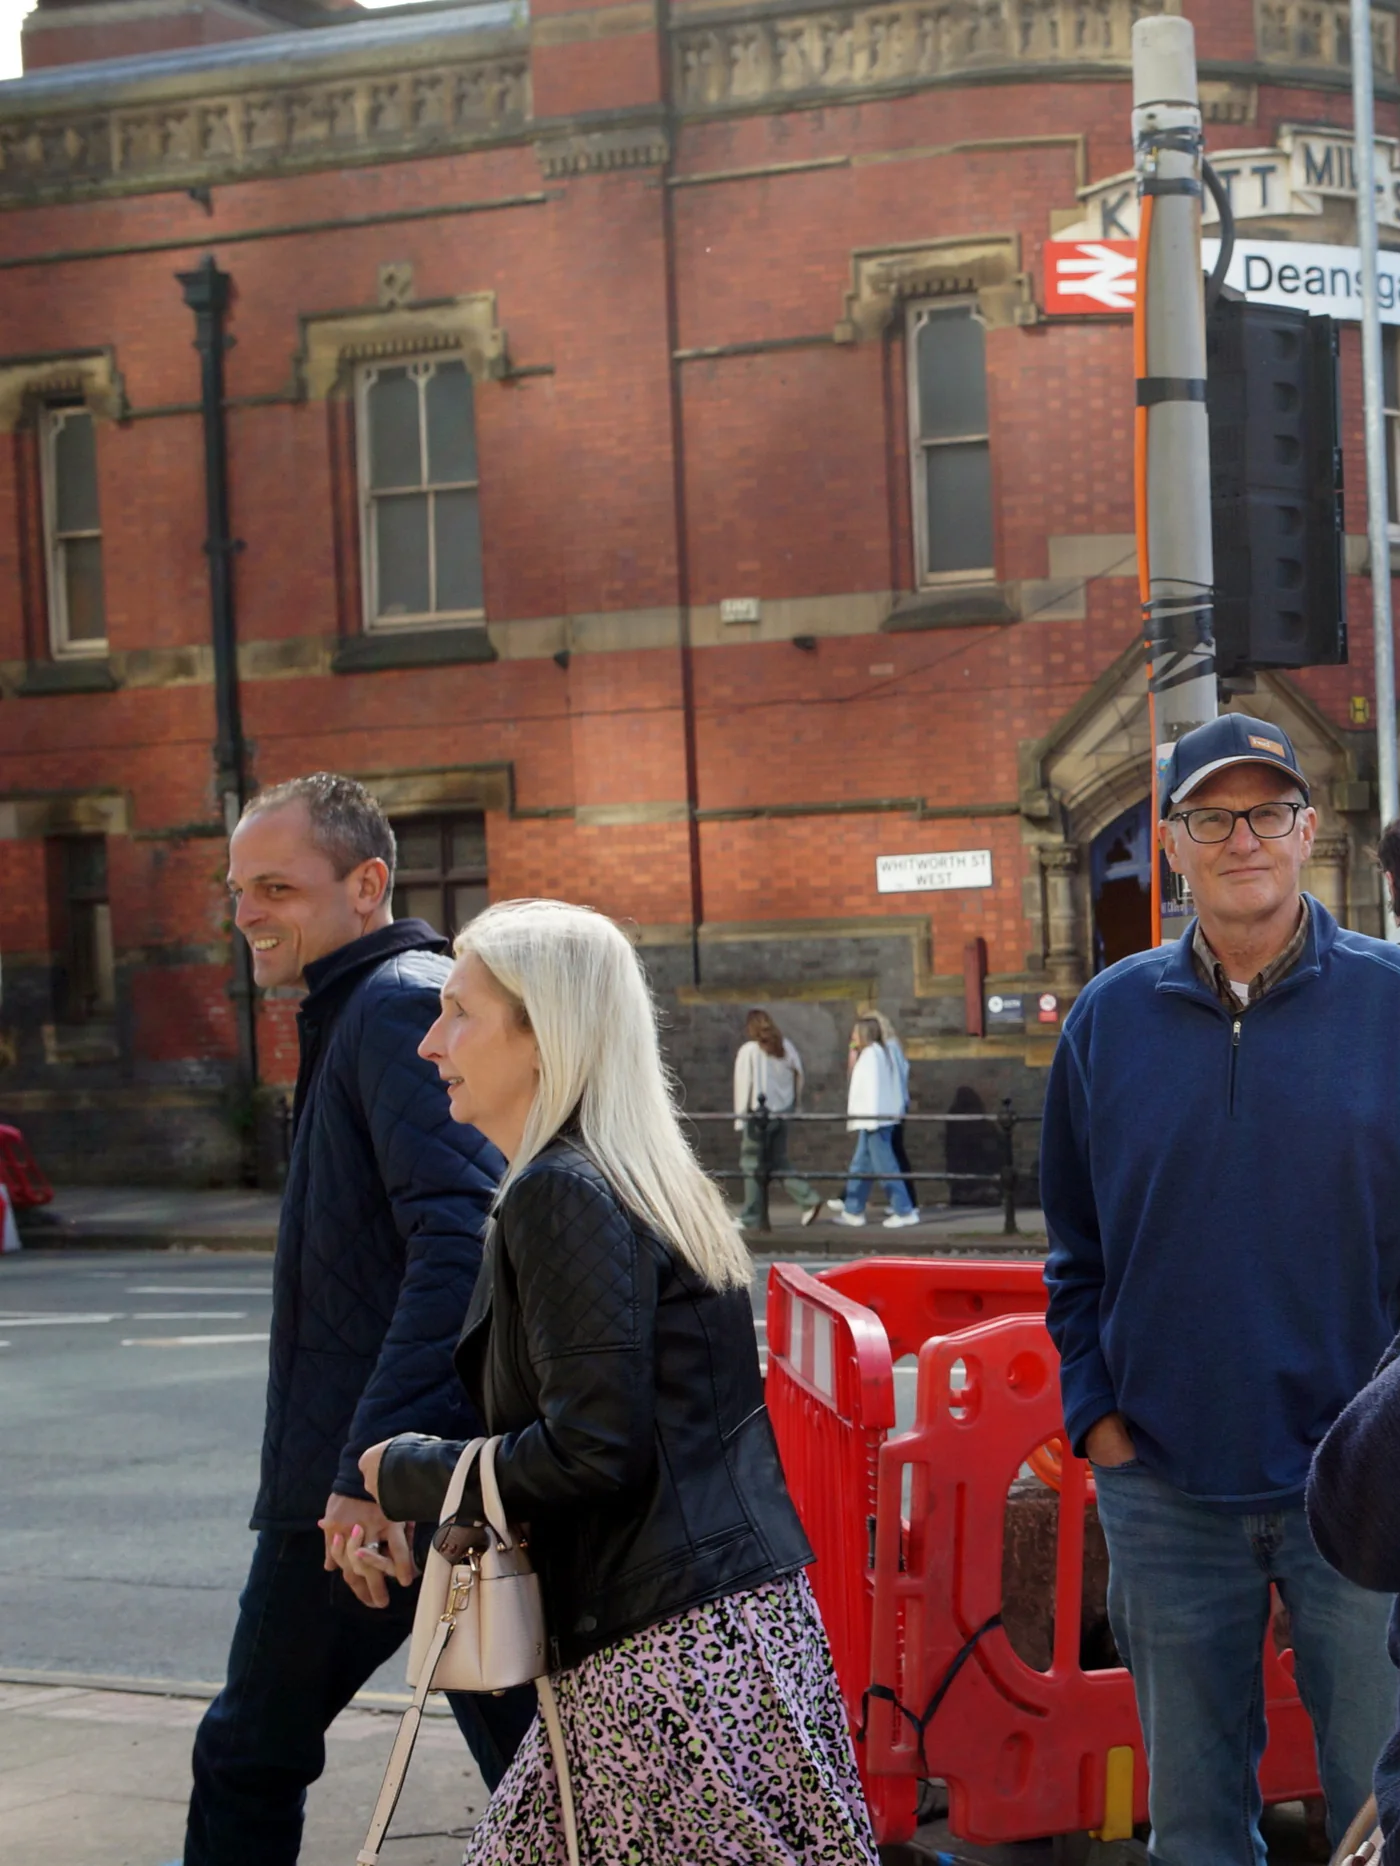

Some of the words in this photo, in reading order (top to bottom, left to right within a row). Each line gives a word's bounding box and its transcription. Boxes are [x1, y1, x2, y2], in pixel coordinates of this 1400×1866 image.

[1102, 165, 1276, 238] KTT
[1304, 142, 1384, 193] MIL
[881, 855, 967, 872] WHITWORTH
[971, 854, 986, 868] ST
[916, 872, 952, 885] WEST
